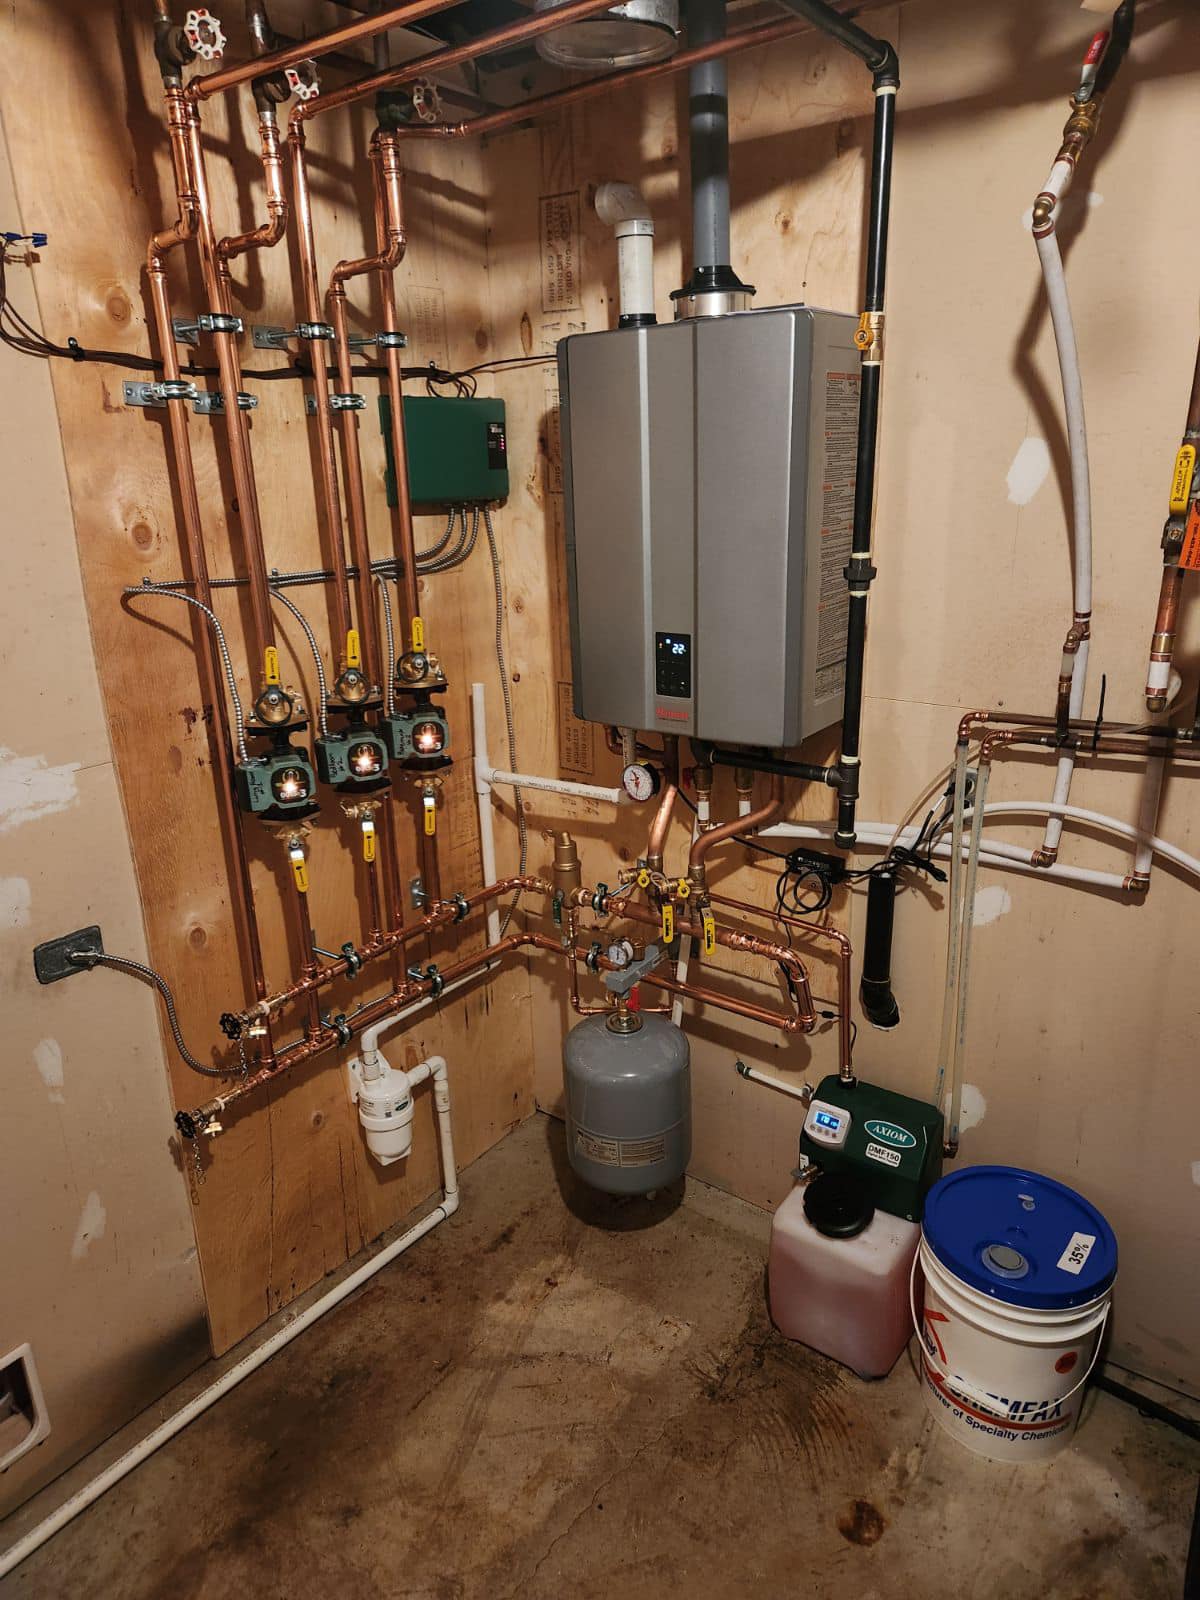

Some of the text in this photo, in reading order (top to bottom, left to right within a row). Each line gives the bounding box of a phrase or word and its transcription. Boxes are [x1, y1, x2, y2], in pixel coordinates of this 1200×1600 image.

[872, 1124, 908, 1143] AXIOM
[867, 1144, 900, 1163] DMF150
[1068, 1243, 1090, 1265] 35%
[952, 1408, 964, 1420] of
[964, 1415, 1019, 1442] Specialty
